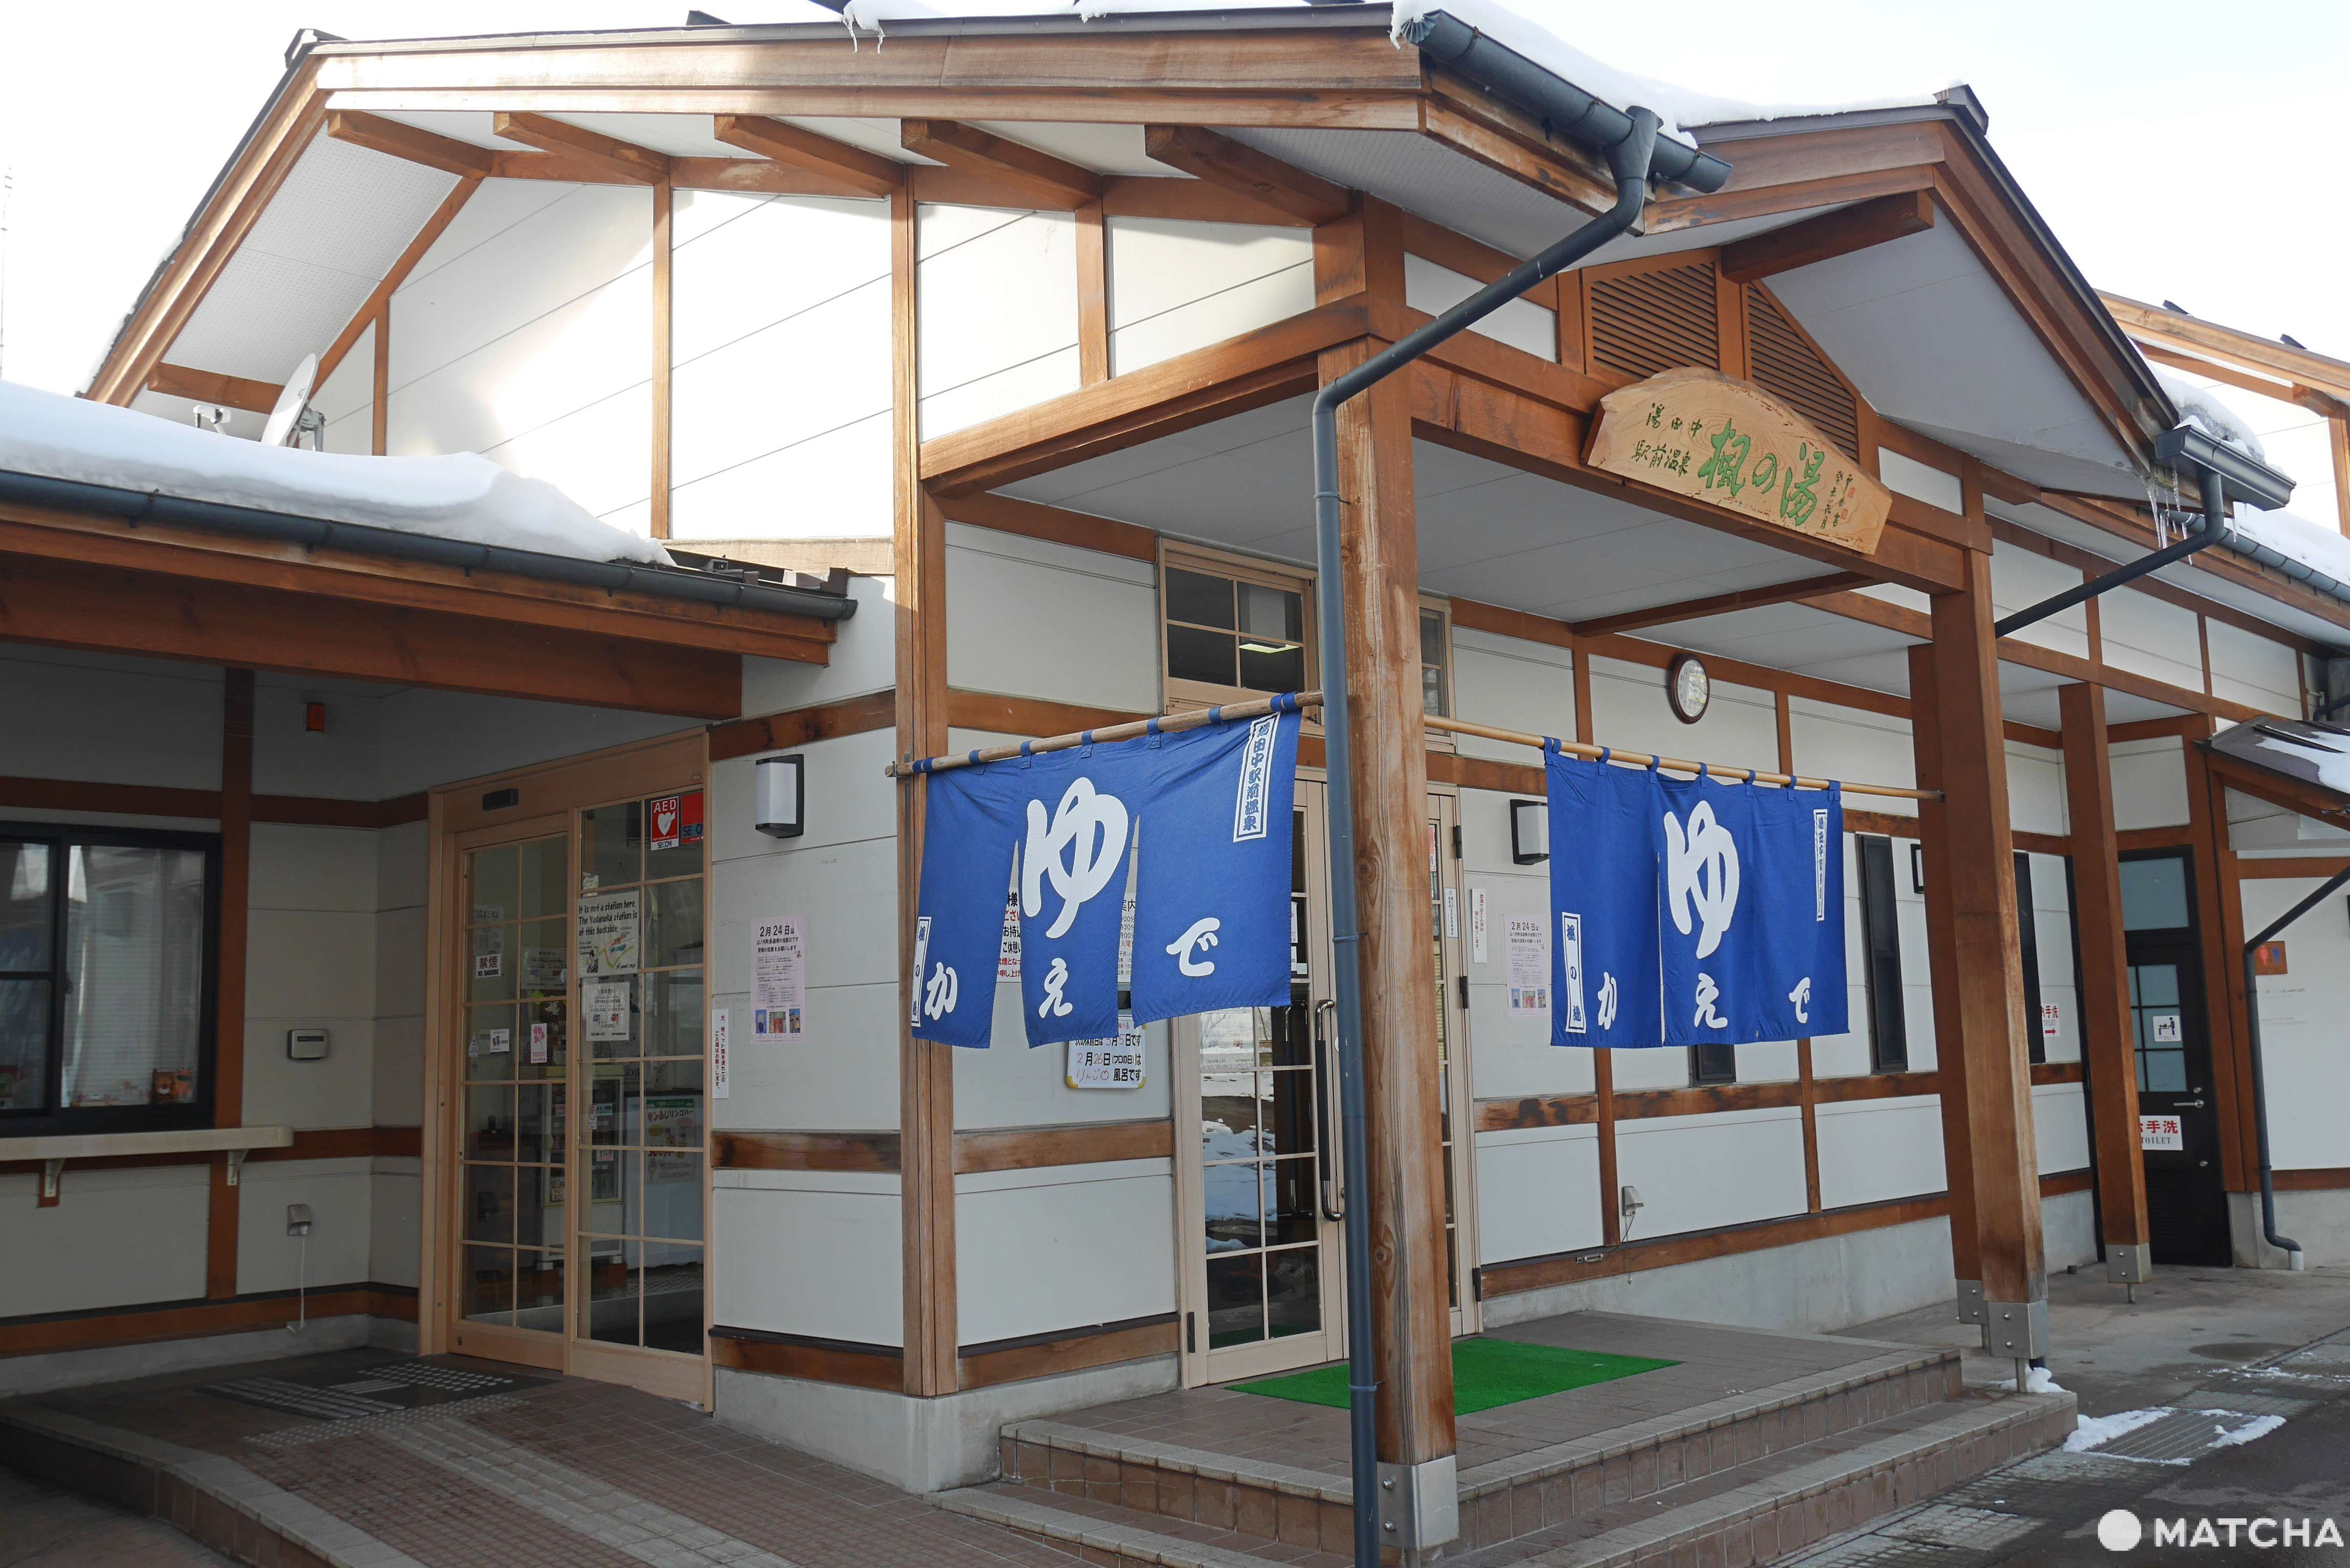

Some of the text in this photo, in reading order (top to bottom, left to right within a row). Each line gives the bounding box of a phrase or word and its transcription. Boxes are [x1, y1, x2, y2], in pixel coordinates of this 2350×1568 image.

[1631, 440, 1690, 477] 駅前温泉
[1698, 418, 1824, 526] 楓の湯
[1243, 722, 1270, 831] 湯田中駅前温泉
[654, 799, 676, 813] AED
[683, 823, 703, 837] SECO
[657, 840, 672, 848] SECOM
[1022, 777, 1128, 939] ゆ
[1664, 800, 1739, 960] ゆ
[584, 905, 589, 913] is
[605, 902, 622, 910] station
[579, 911, 637, 925] The Yudanaka station is
[579, 928, 583, 936] at
[585, 927, 595, 935] this
[479, 955, 498, 969] 禁煙
[924, 918, 1221, 1020] か え で
[1597, 972, 1811, 1030] か え で
[2140, 1121, 2178, 1134] 手洗
